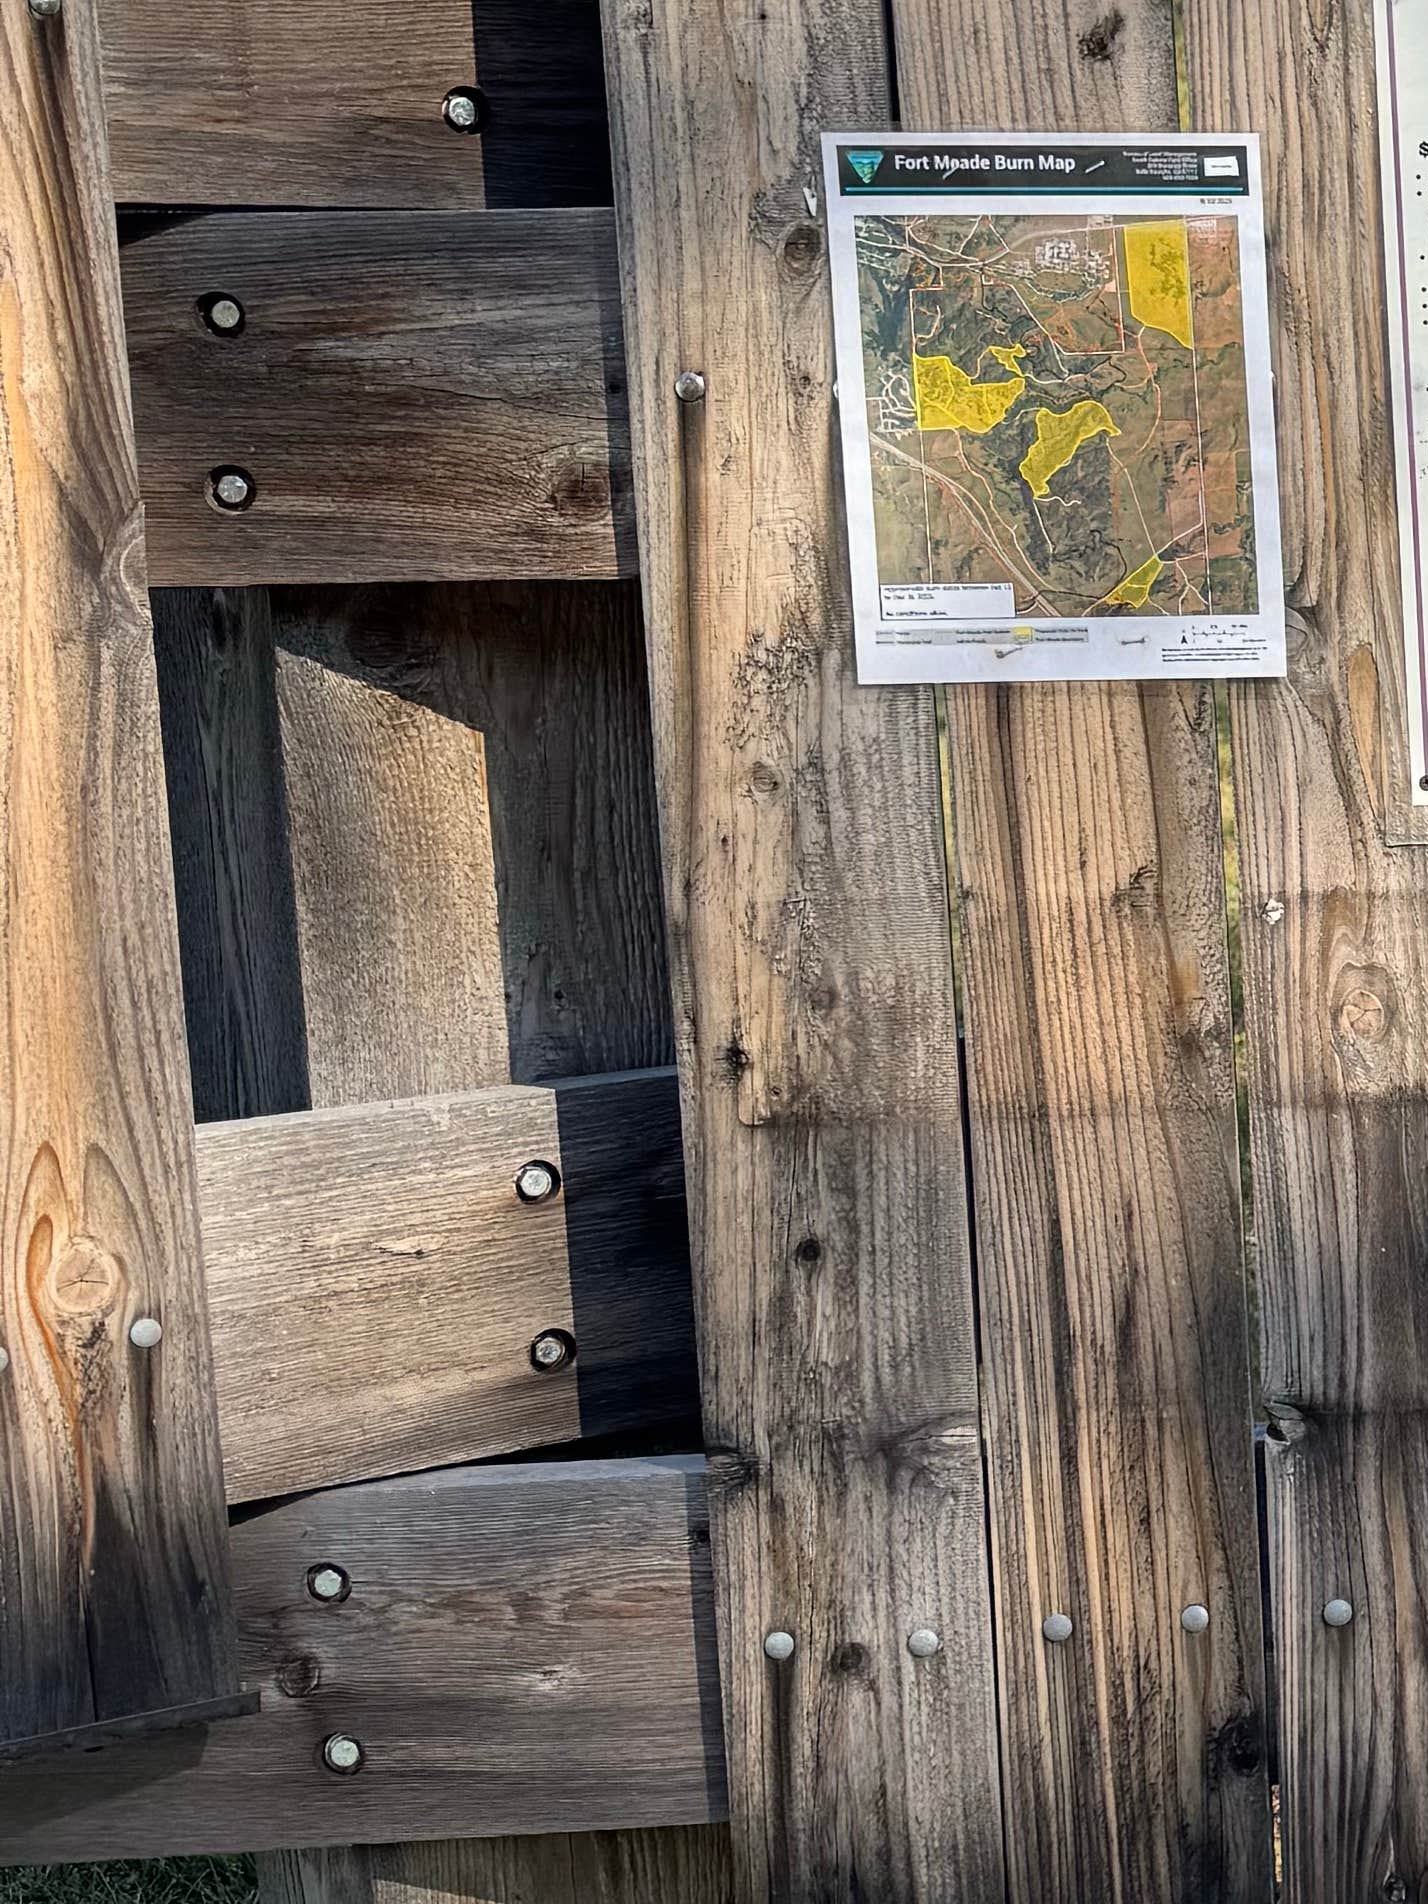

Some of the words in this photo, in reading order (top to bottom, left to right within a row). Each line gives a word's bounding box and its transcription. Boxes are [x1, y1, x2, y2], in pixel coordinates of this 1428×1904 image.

[894, 154, 930, 171] Fort
[994, 154, 1035, 171] Burn
[1039, 154, 1076, 174] Map
